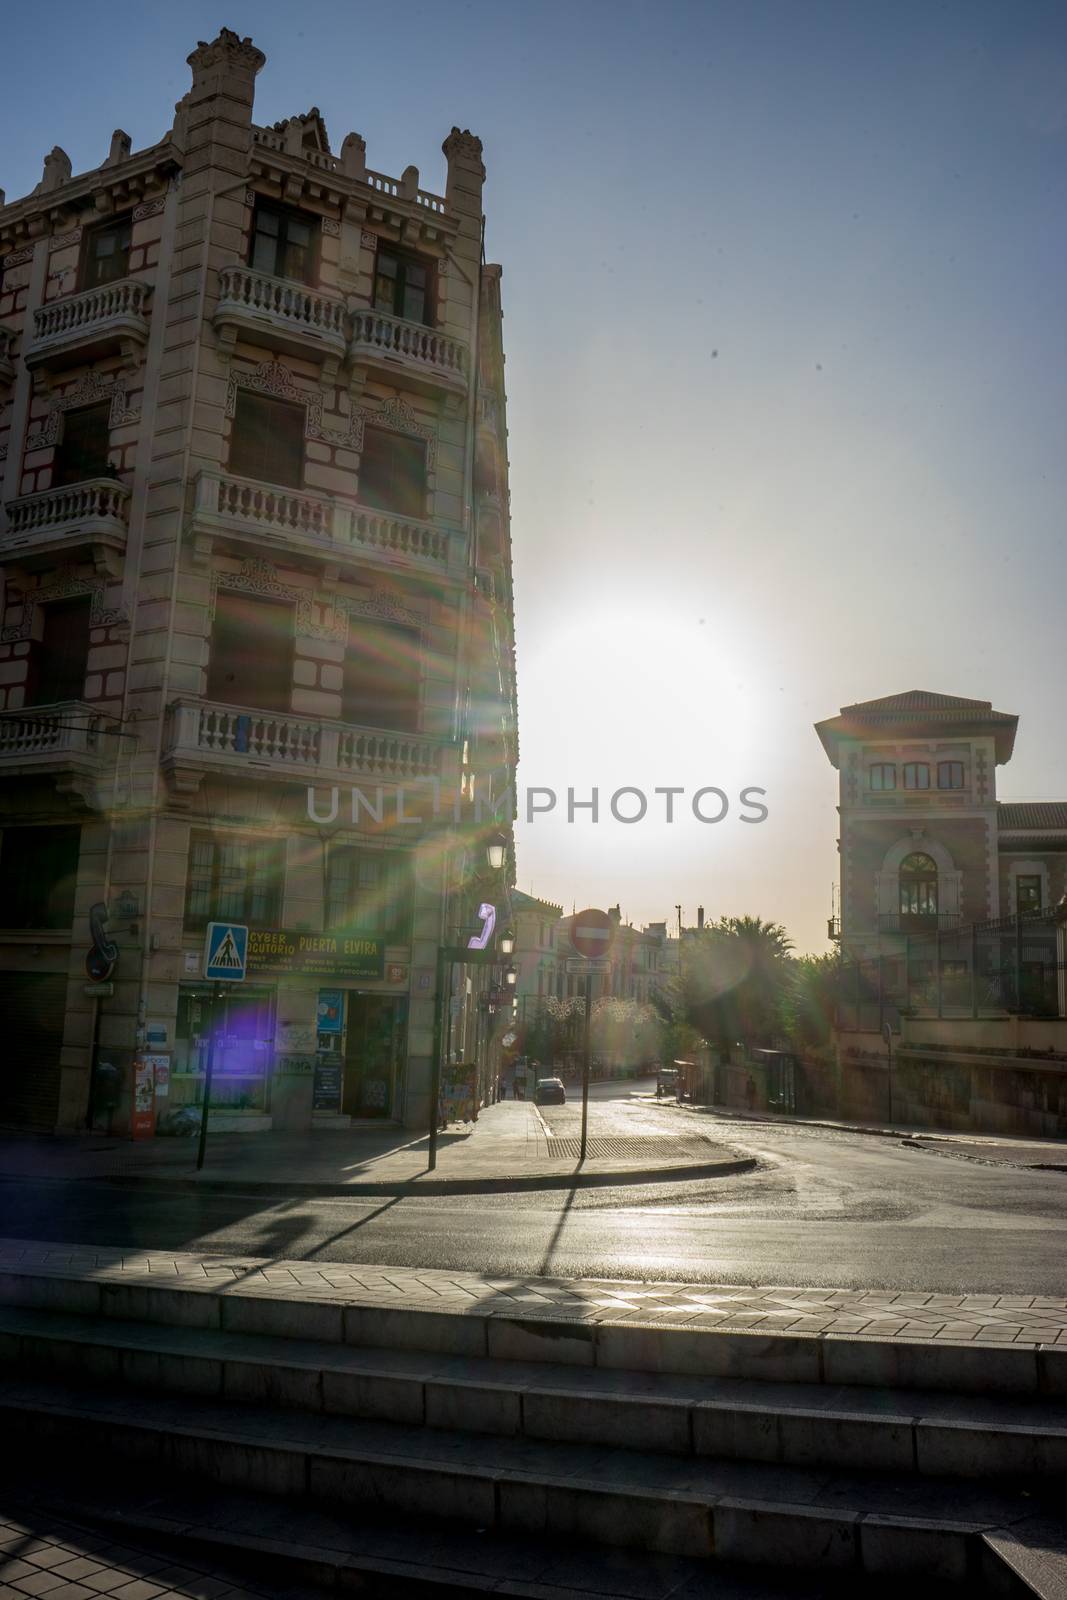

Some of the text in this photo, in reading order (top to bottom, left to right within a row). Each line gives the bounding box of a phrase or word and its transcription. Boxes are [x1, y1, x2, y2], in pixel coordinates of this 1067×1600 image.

[249, 932, 287, 944] CYBER
[299, 936, 377, 954] PUERTA ELVIRA
